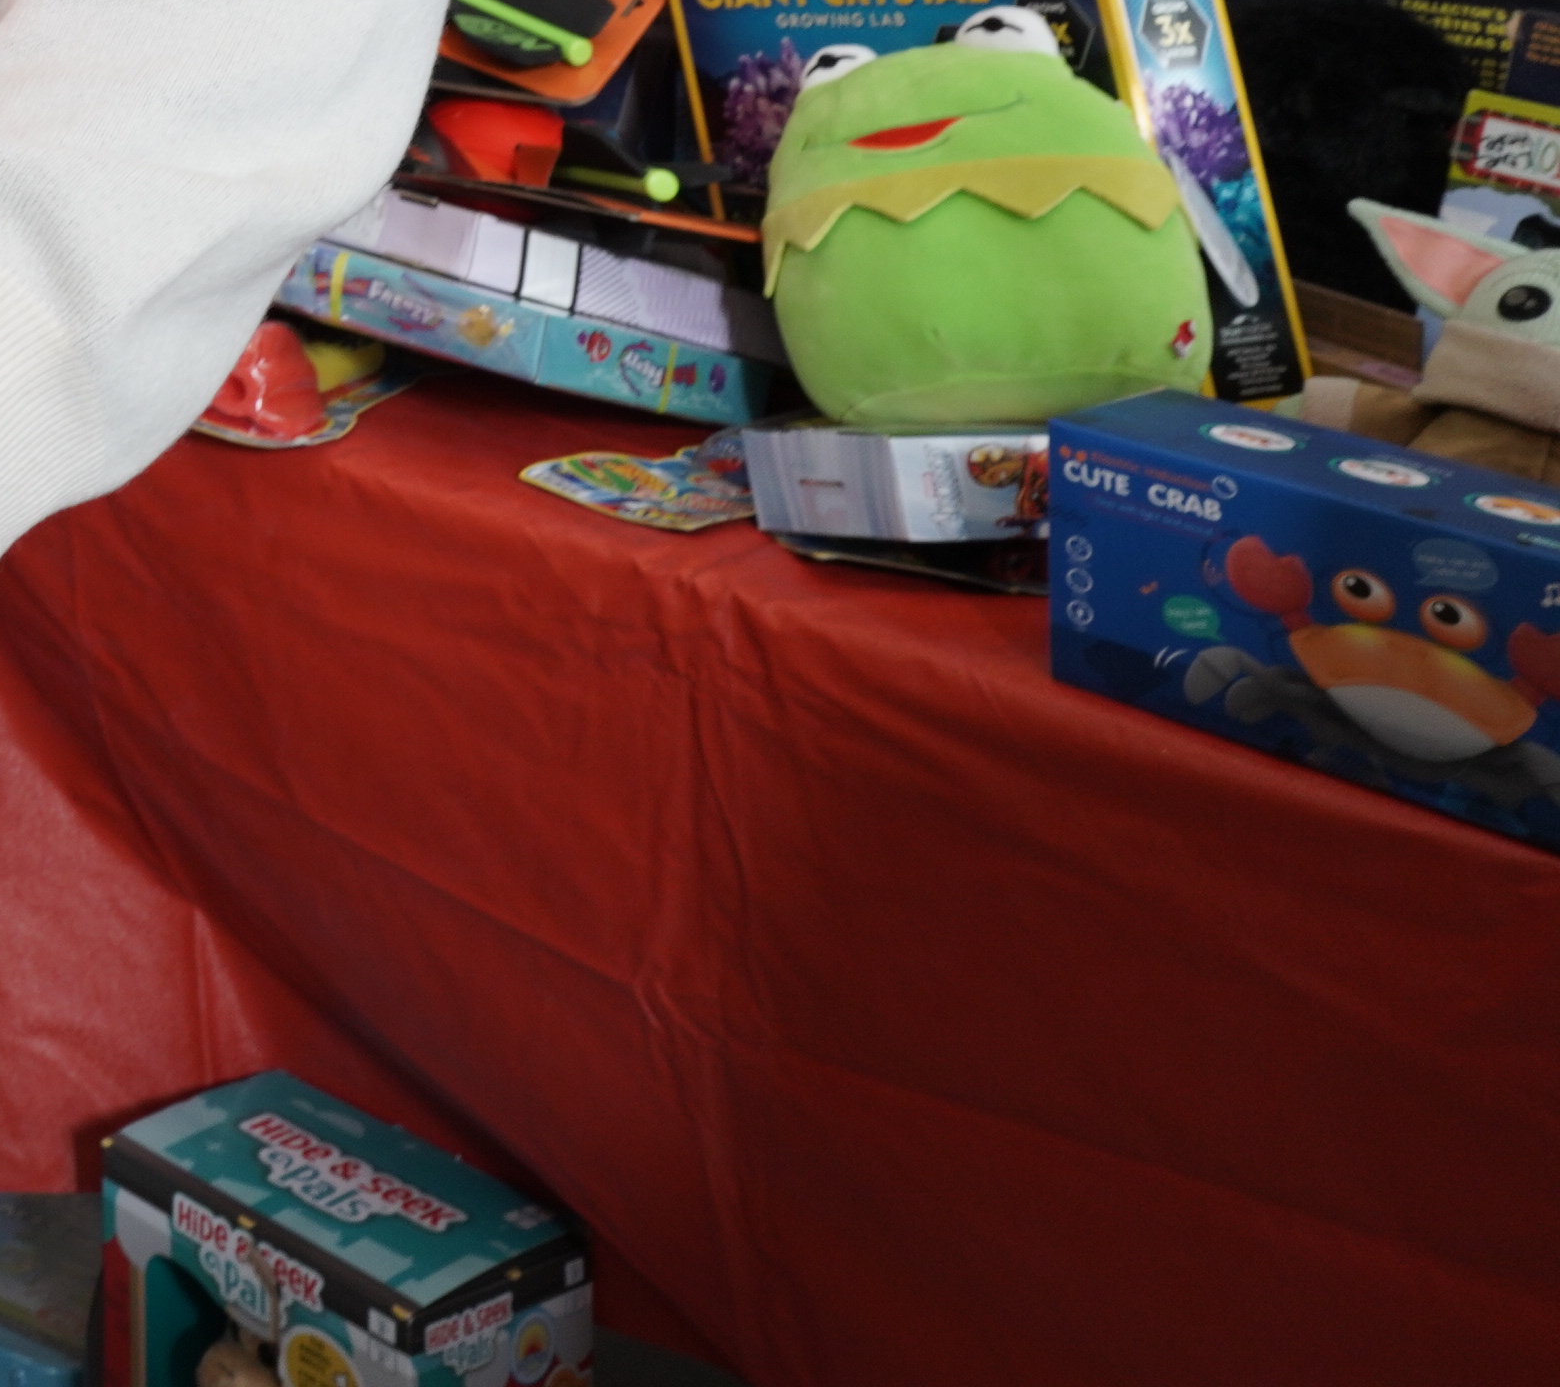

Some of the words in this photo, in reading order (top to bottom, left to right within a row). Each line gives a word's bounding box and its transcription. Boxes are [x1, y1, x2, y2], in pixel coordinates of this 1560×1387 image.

[776, 13, 864, 29] GROWING
[871, 11, 906, 27] LAB
[1063, 459, 1130, 497] CUTE
[1147, 483, 1222, 522] CRAB
[330, 1157, 361, 1181] &
